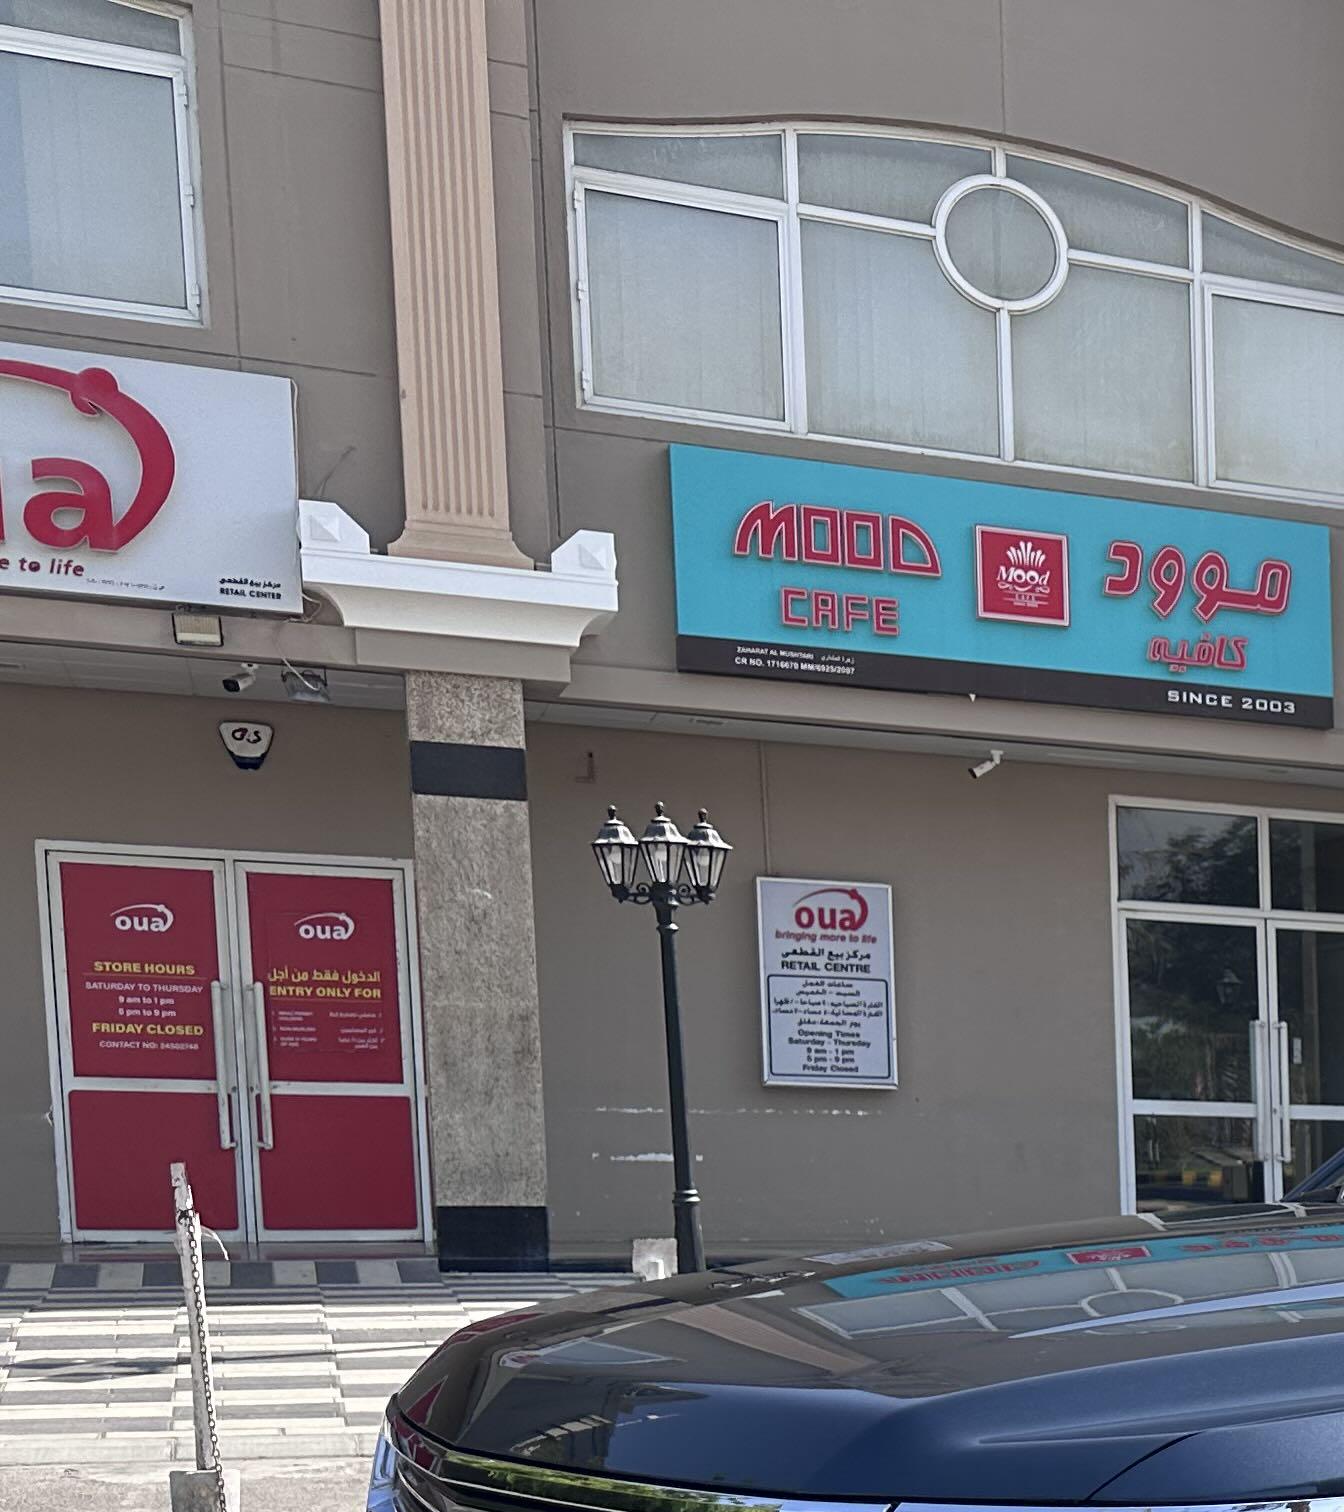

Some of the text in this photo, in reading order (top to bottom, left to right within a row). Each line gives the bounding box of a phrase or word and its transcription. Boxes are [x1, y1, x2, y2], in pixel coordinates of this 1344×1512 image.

[734, 500, 942, 577] MOOD
[19, 557, 41, 572] to
[49, 558, 85, 577] life
[997, 565, 1051, 585] Mood
[1104, 541, 1292, 622] موود
[220, 587, 282, 600] RETAIL CENTER
[780, 586, 900, 636] CAFE
[1148, 633, 1248, 673] كافيه
[734, 656, 748, 665] CR
[1168, 690, 1297, 714] SINCE 2003
[114, 908, 173, 932] oua
[794, 899, 867, 931] oua
[298, 918, 355, 940] oua
[775, 930, 877, 944] bringing more to life
[93, 961, 196, 975] STORE HOURS
[781, 960, 871, 973] RETAIL CENTRE
[291, 968, 309, 982] من
[312, 969, 340, 981] فقط
[343, 971, 381, 984] الدخول
[86, 981, 203, 993] SATURDAY TO THURSDAY
[270, 986, 381, 998] ENTRY ONLY FOR
[142, 996, 152, 1005] to
[126, 1009, 141, 1017] pm
[142, 1008, 152, 1017] to
[161, 1010, 177, 1018] pm
[92, 1022, 204, 1036] FRIDAY CLOSED
[797, 1029, 860, 1038] Opening Times
[99, 1041, 141, 1049] CONTACT
[788, 1037, 825, 1046] Saturday
[834, 1039, 871, 1048] Thursday
[802, 1064, 828, 1072] Friday
